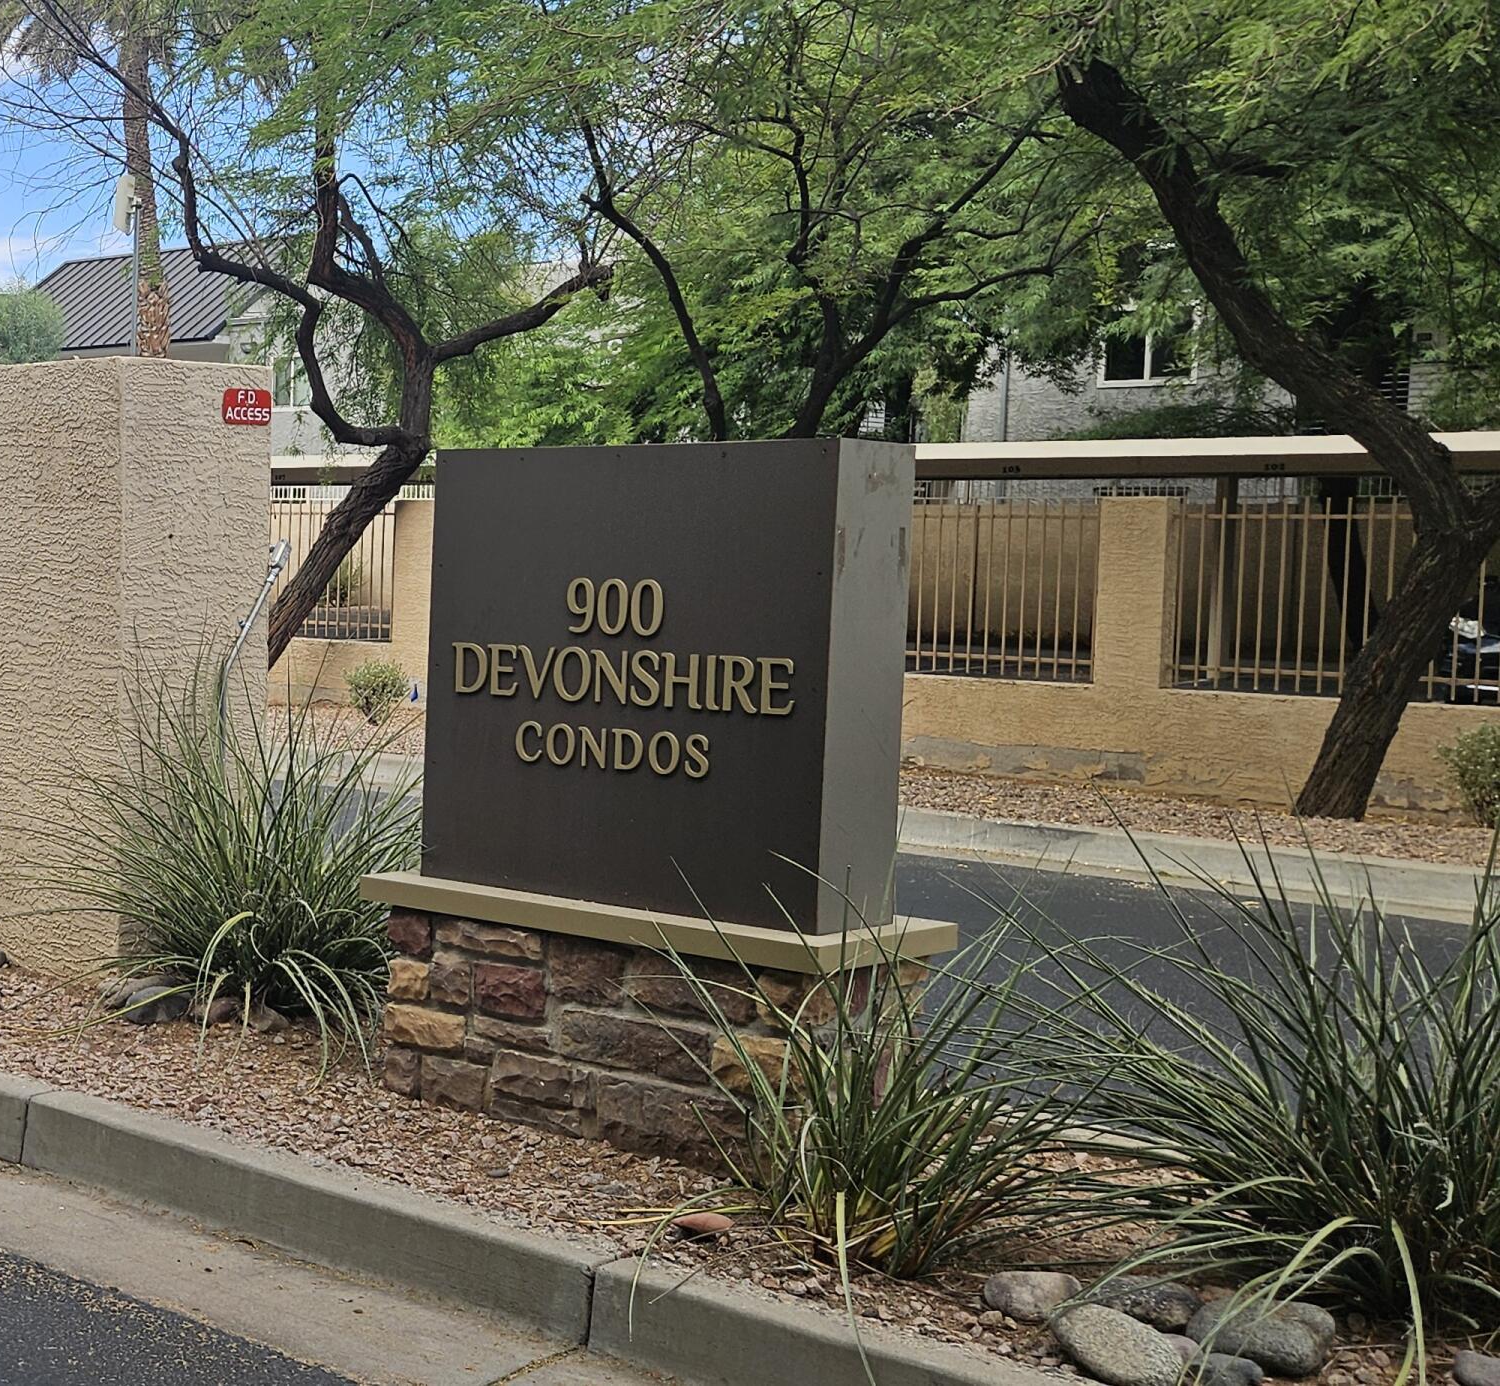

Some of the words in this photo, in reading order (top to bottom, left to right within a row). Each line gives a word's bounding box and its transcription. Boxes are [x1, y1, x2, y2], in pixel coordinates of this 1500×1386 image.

[225, 406, 270, 421] ACCESS
[237, 390, 259, 405] F.D.
[566, 577, 664, 636] 900
[452, 641, 795, 715] DEVONSHIRE
[514, 720, 709, 778] CONDOS
